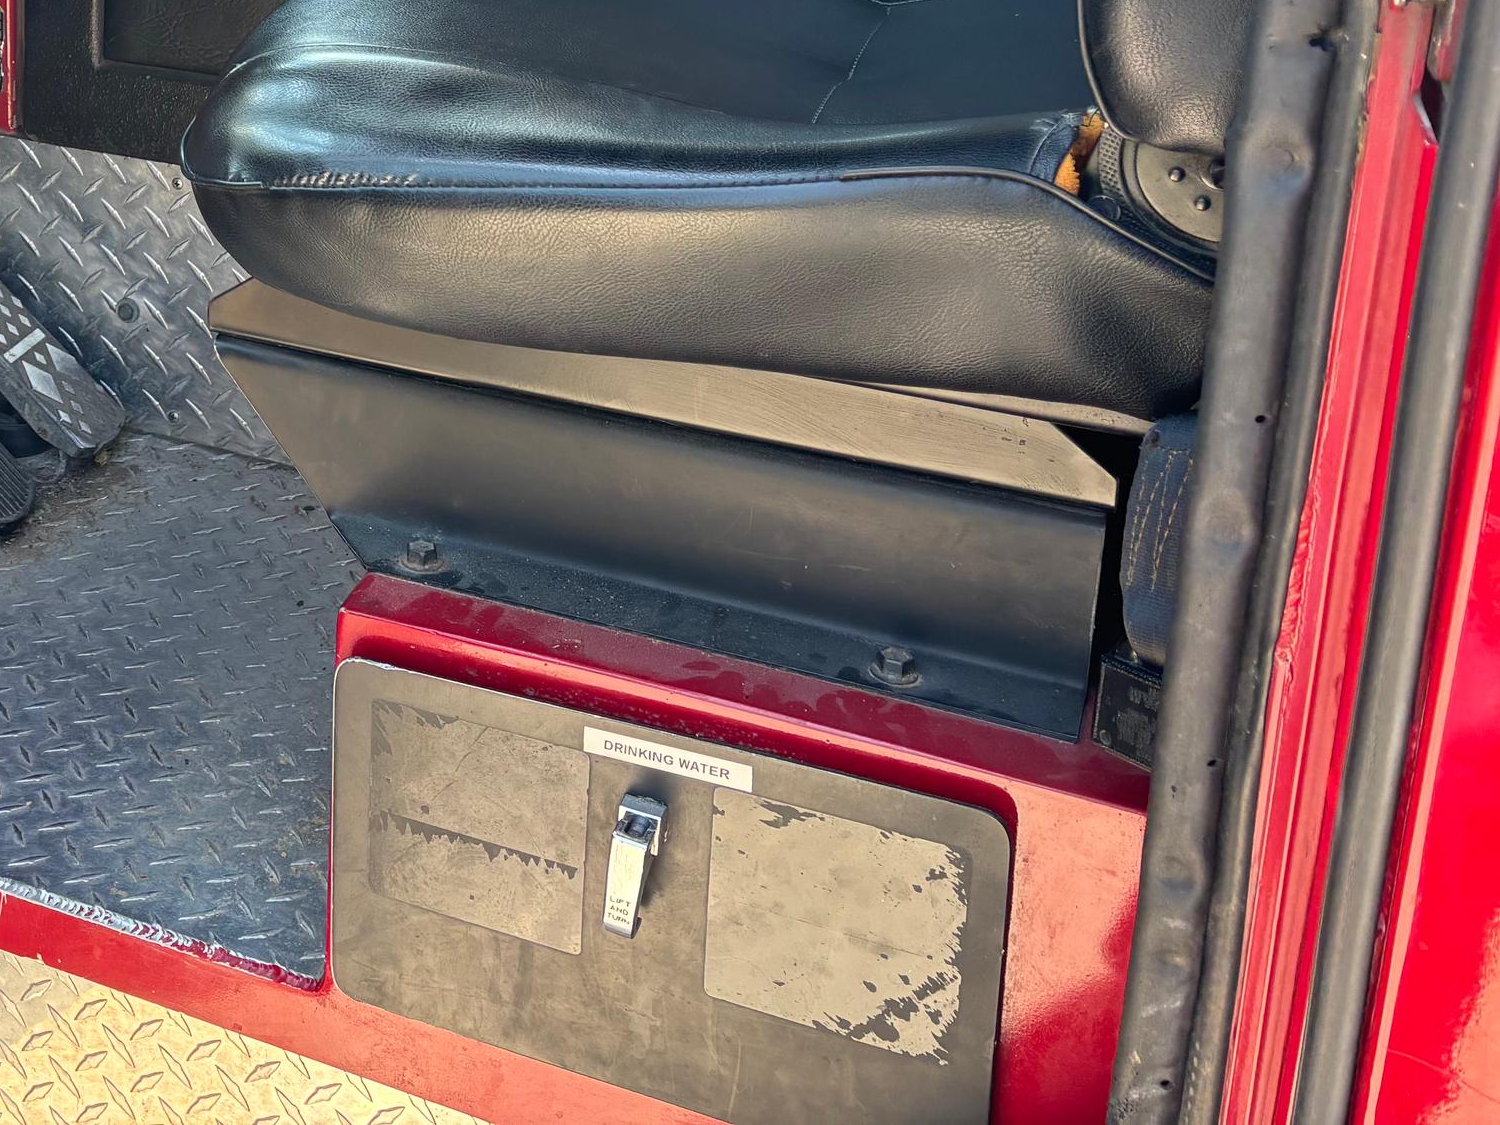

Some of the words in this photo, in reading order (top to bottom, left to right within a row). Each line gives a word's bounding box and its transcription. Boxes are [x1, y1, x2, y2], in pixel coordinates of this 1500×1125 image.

[603, 739, 674, 766] DRINKING
[678, 756, 730, 780] WATER
[609, 895, 631, 907] LIFT
[610, 905, 629, 916] AND
[607, 912, 630, 925] TURN
